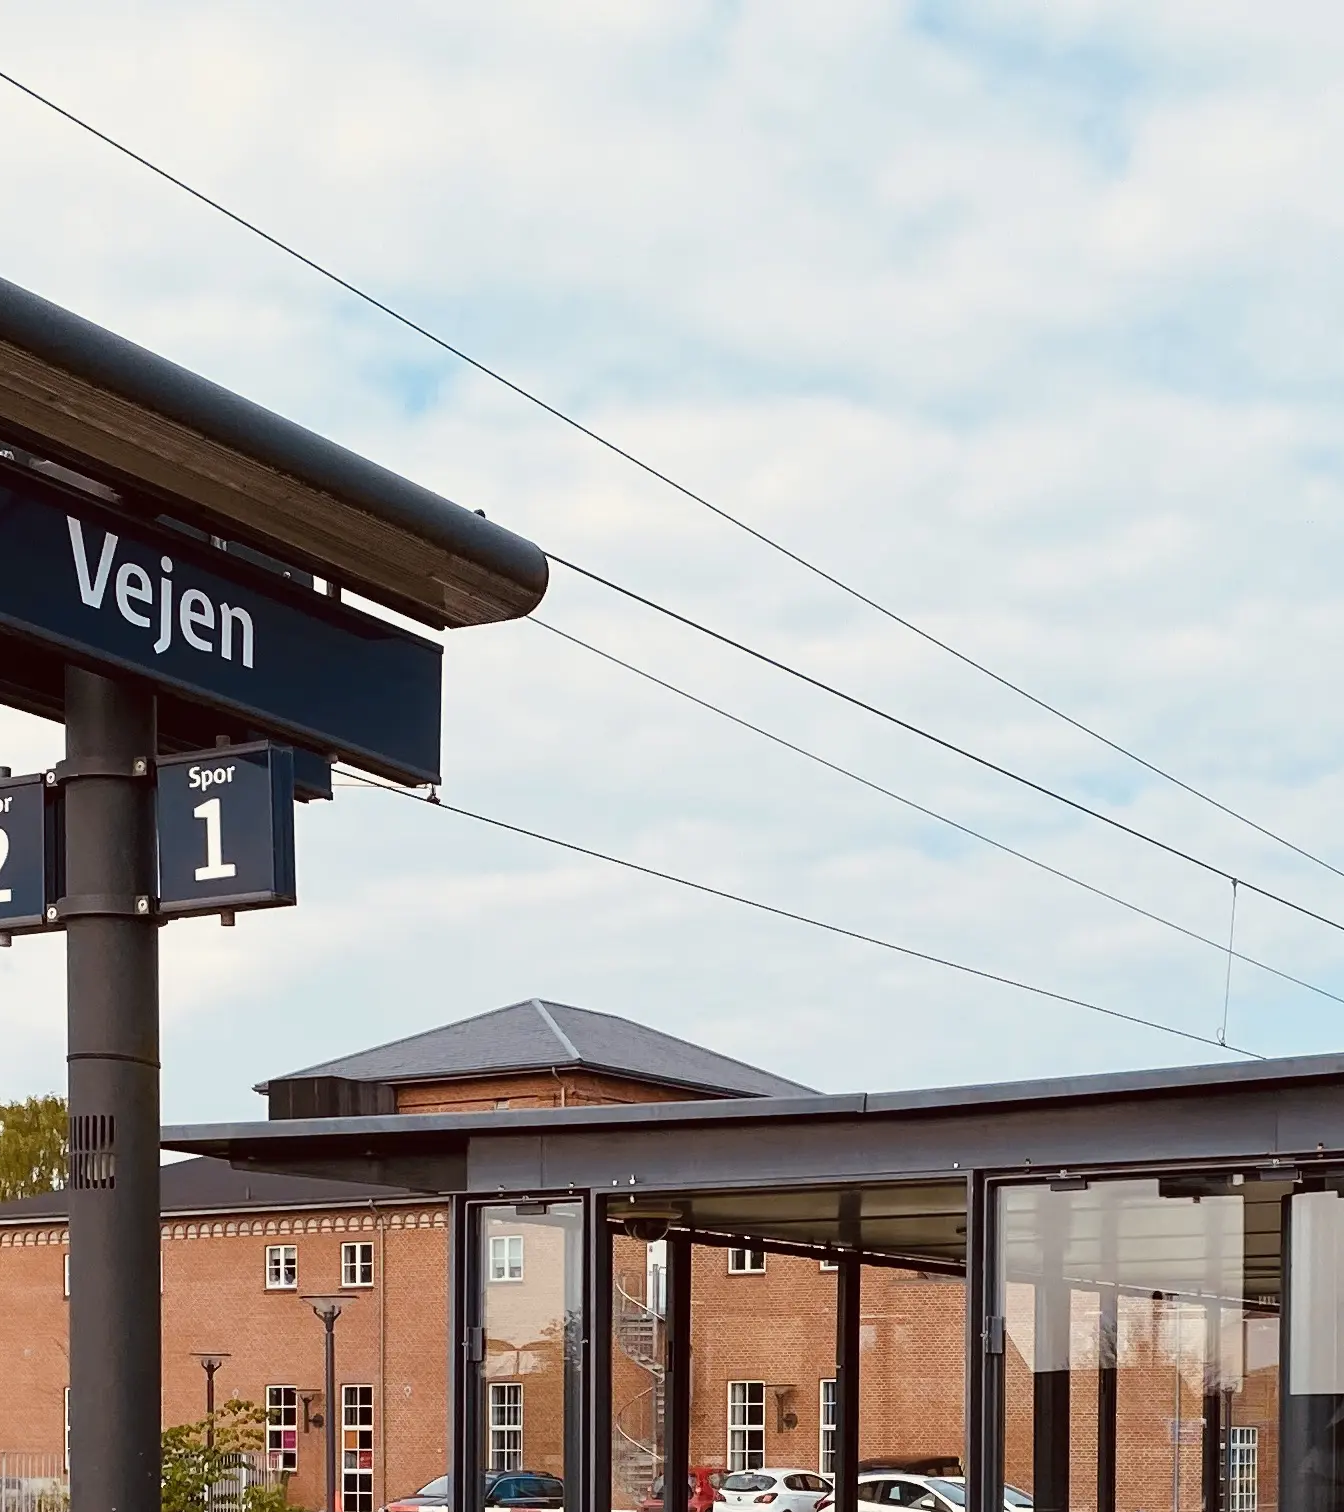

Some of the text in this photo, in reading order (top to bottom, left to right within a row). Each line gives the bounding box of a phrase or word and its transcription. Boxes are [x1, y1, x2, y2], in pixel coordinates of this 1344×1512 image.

[67, 515, 253, 669] Vejen
[188, 764, 236, 791] Spor
[193, 798, 237, 881] 1
